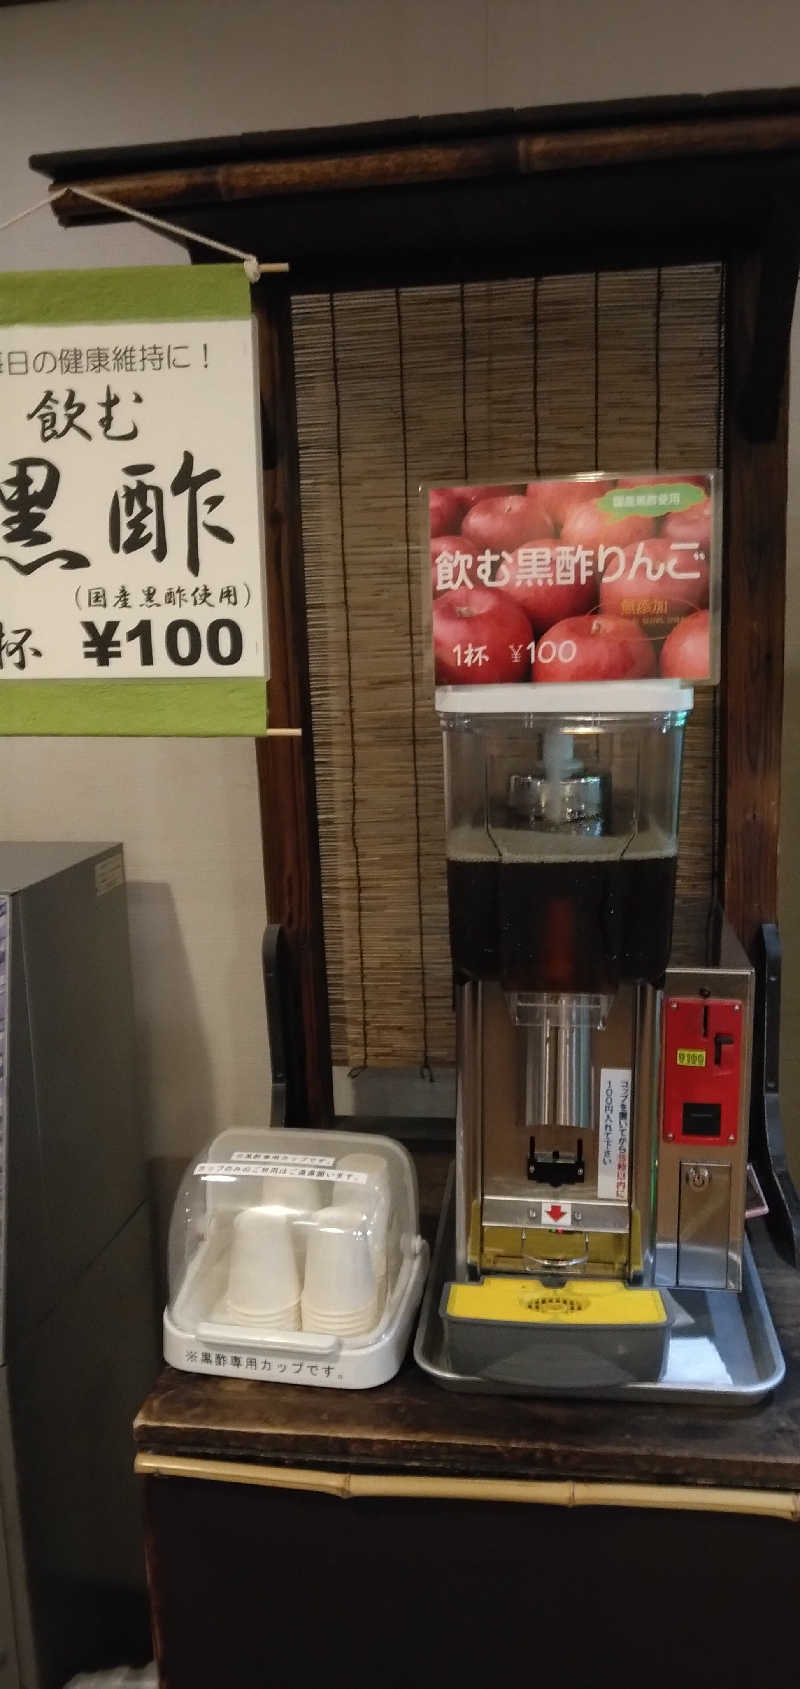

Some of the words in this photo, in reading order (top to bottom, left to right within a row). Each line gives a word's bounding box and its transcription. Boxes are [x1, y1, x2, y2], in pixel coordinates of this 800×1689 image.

[0, 344, 210, 376] 日の健康維持に！
[27, 384, 143, 443] 飲む
[435, 542, 706, 592] 飲む黒酢りんご
[81, 618, 244, 668] ¥100
[452, 643, 490, 668] 1杯
[509, 640, 577, 665] ¥100
